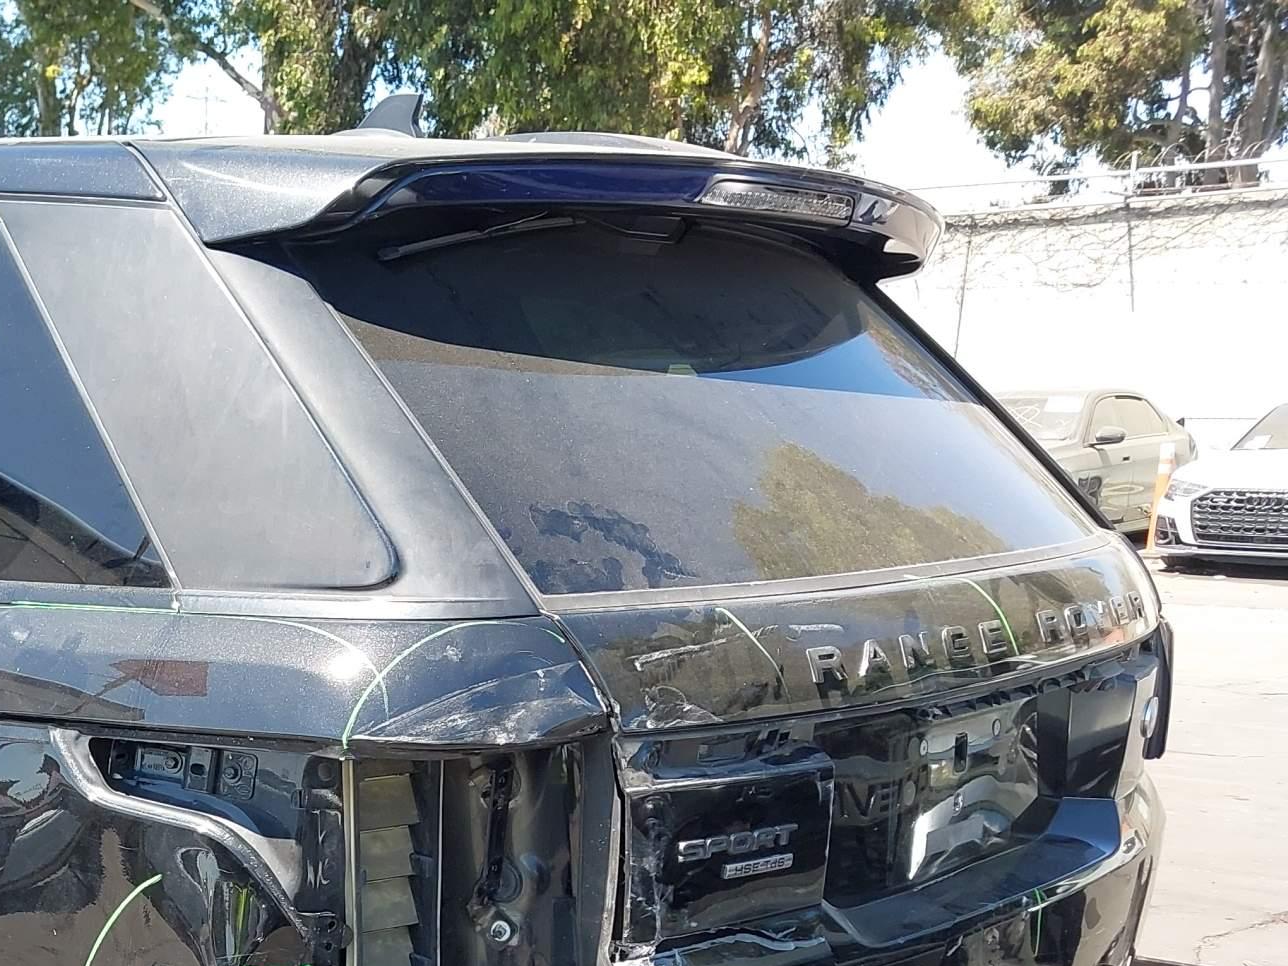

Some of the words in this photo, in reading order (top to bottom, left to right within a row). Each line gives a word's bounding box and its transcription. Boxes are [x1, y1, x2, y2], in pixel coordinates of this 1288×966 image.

[806, 620, 1009, 684] RANGE
[1036, 591, 1145, 643] ROVER
[678, 823, 799, 863] SPORT
